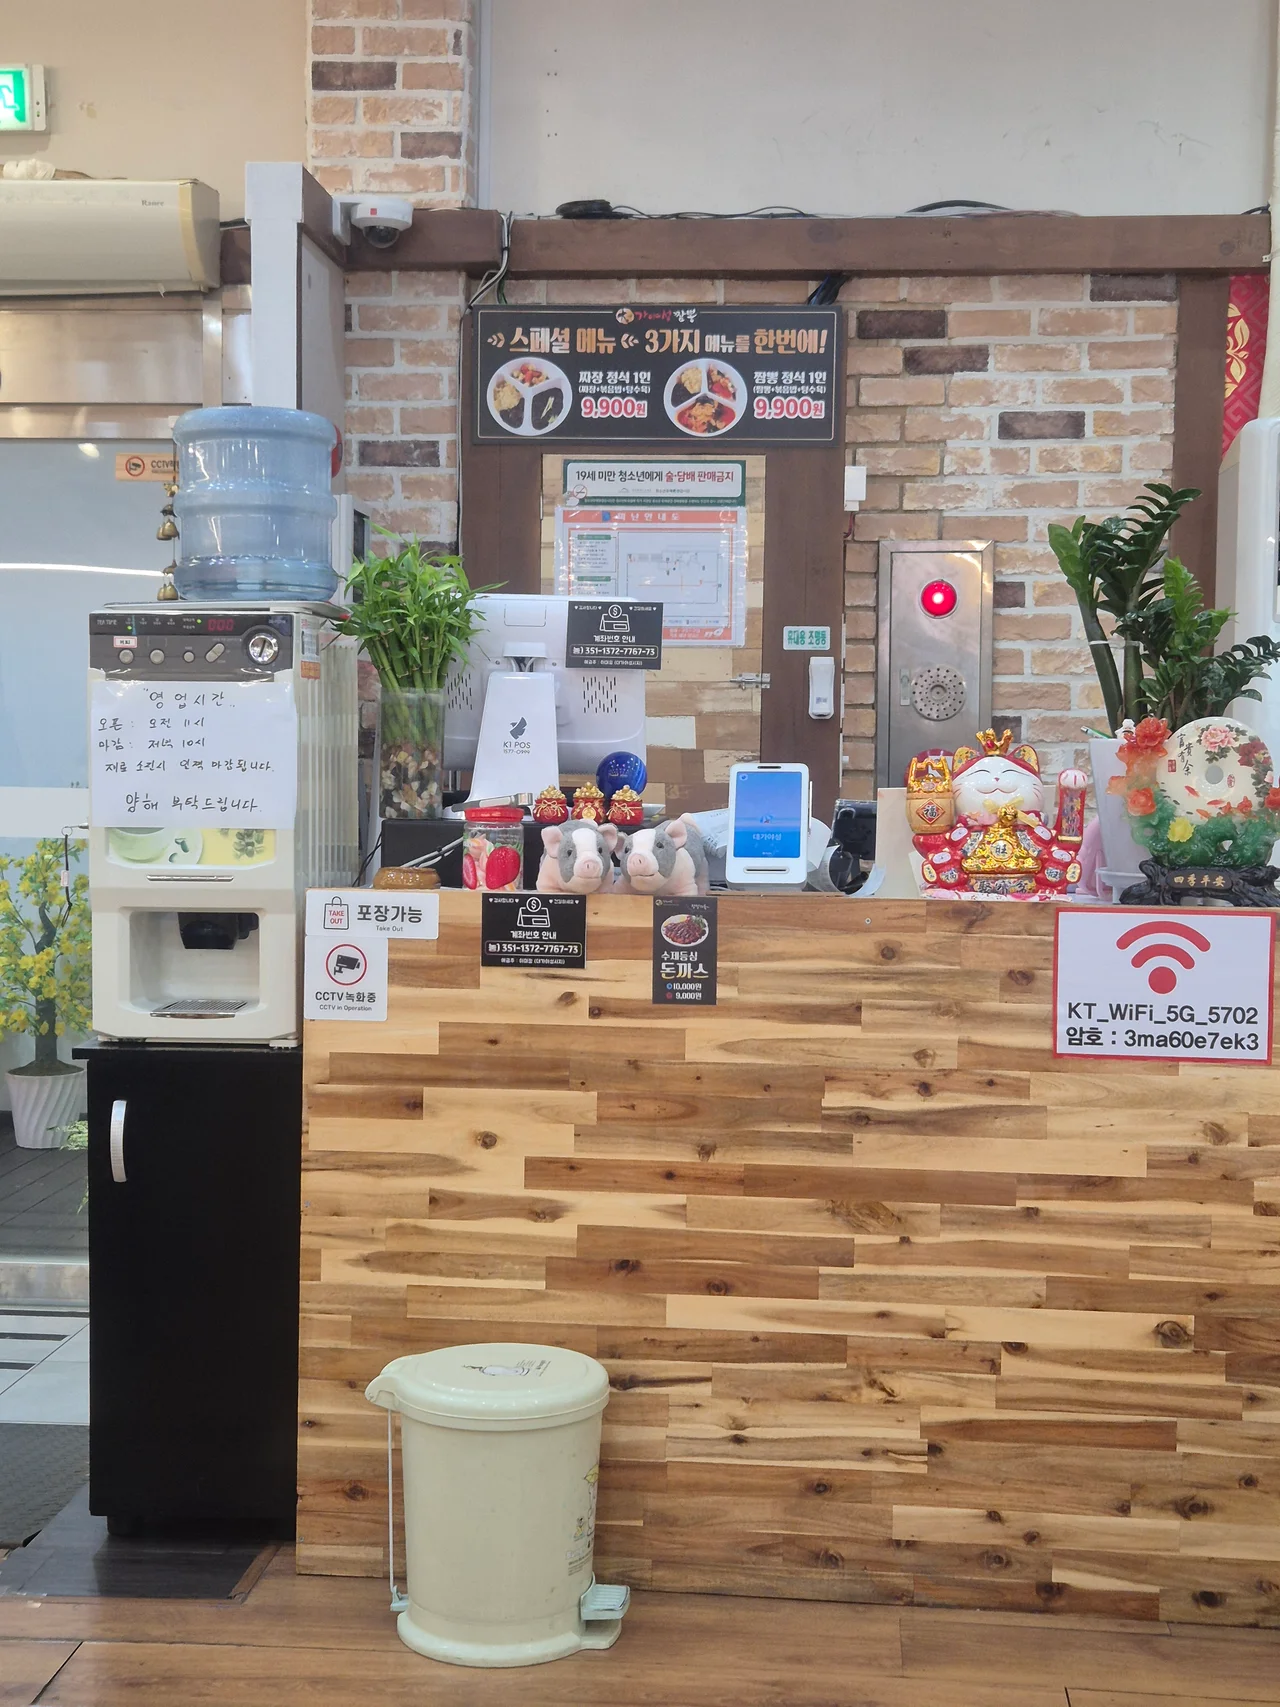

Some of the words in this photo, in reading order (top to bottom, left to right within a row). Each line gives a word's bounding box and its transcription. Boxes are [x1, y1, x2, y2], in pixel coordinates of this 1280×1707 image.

[509, 327, 571, 354] 스페셜
[576, 327, 617, 354] 메뉴
[644, 328, 701, 354] 3가지
[704, 334, 750, 354] 메뉴를
[753, 328, 828, 354] 한번에!
[578, 371, 604, 384] 짜장
[606, 371, 630, 384] 정식
[633, 371, 651, 384] 1인
[753, 371, 779, 384] 짬뽕
[781, 371, 806, 384] 정식
[808, 371, 827, 384] 1인
[581, 396, 648, 418] 9,900원
[753, 396, 825, 419] 9,900원
[576, 470, 596, 482] 19세
[597, 470, 616, 482] 미만
[618, 471, 663, 482] 청소년에게
[697, 471, 735, 483] 판매금지
[593, 635, 620, 643] 계좌번호
[621, 635, 636, 643] 안내
[585, 647, 656, 656] 351-1372-7767-73
[149, 717, 171, 728] 오전
[182, 737, 205, 748] 10시
[514, 741, 531, 749] POS
[105, 761, 128, 773] 재료
[136, 760, 166, 772] 소진시
[125, 791, 159, 813] 양해
[1173, 873, 1226, 888] 四季平安
[328, 909, 345, 917] TAKE
[356, 904, 423, 924] 포장가능
[509, 930, 540, 939] 계좌번호
[541, 931, 557, 940] 안내
[501, 943, 579, 954] 351-1372-7767-73
[660, 950, 698, 961] 수제등심
[660, 962, 709, 980] 돈까스
[315, 991, 345, 1002] CCTV
[1067, 1002, 1259, 1025] KT_WiFi_5G_5702
[1066, 1026, 1103, 1046] 암호
[1123, 1029, 1260, 1051] 3ma60e7ek3
